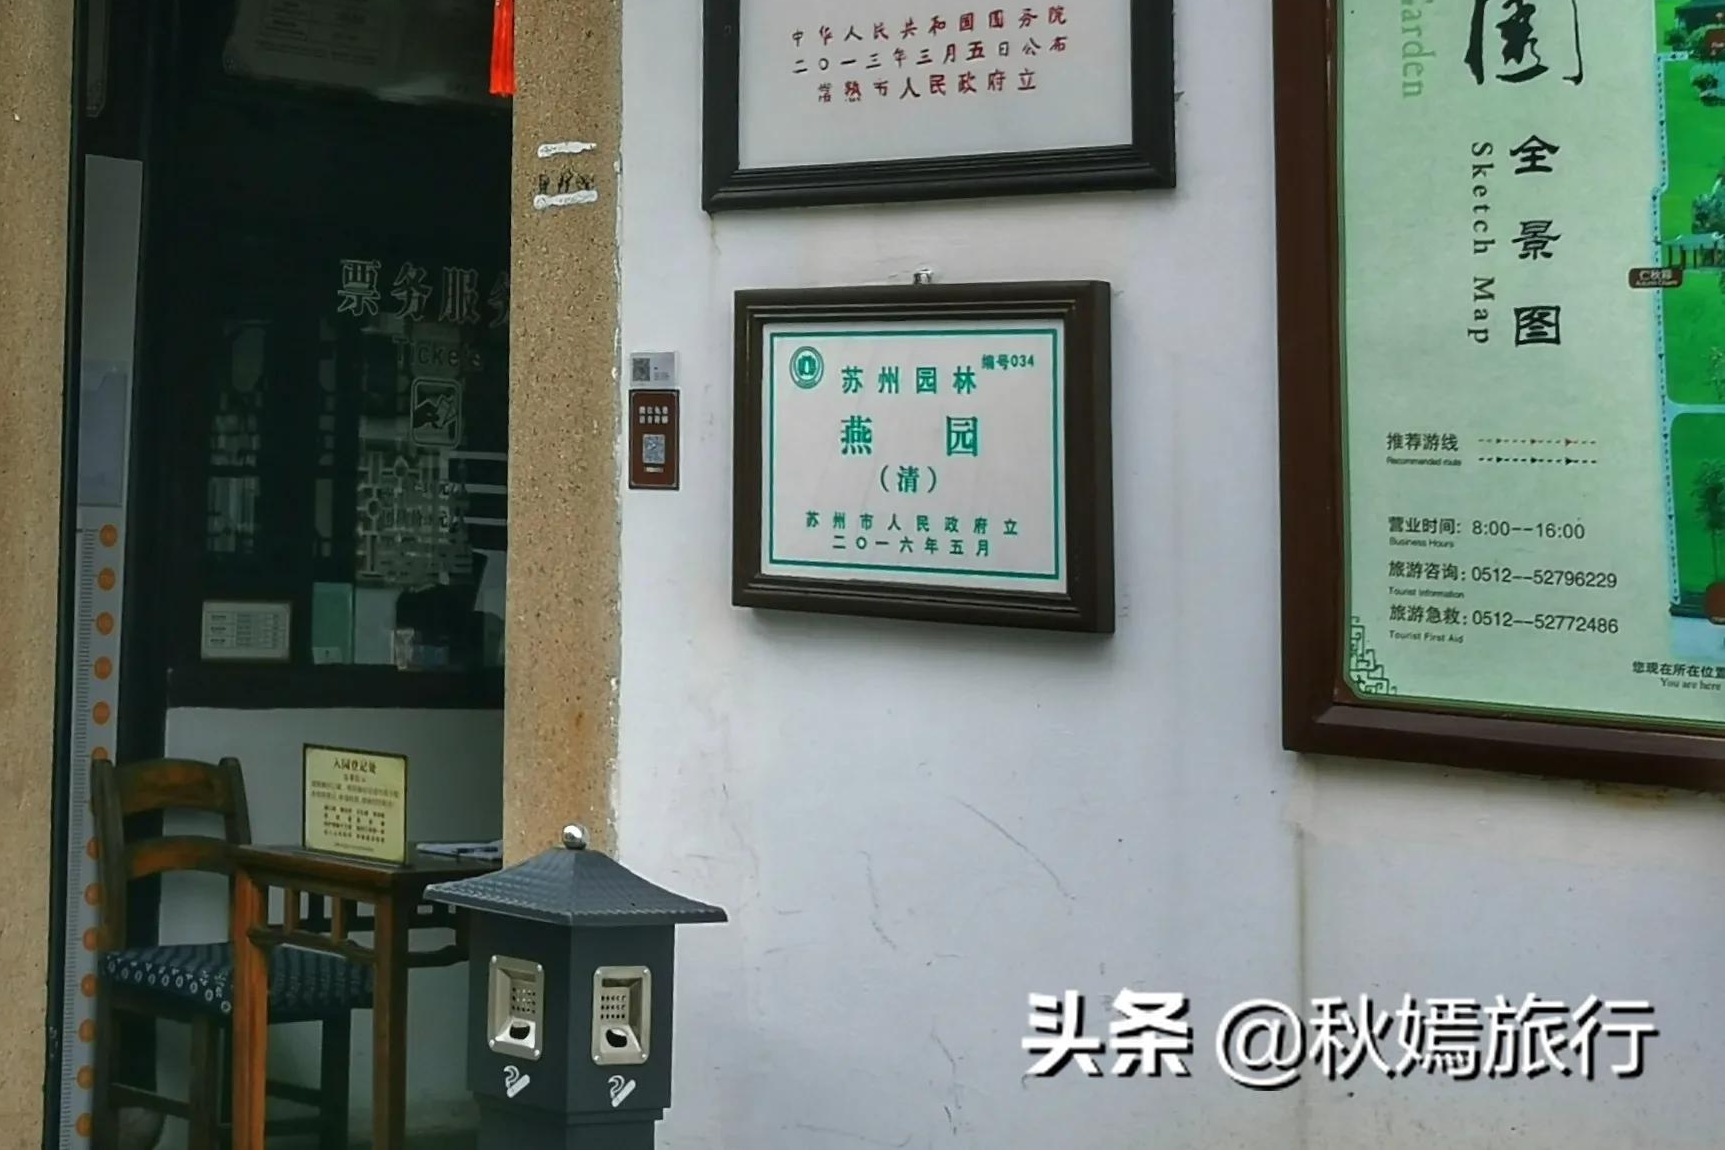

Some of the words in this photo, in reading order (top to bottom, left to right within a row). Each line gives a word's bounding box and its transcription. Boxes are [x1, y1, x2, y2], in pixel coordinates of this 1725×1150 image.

[791, 5, 1069, 47] 中华人民共和国国务院
[817, 67, 1037, 103] 常熟市人民政府立
[1470, 141, 1495, 254] Sketch
[1509, 134, 1562, 346] 全景图
[1466, 276, 1496, 344] Map
[981, 354, 1035, 371] 编号034
[840, 364, 977, 395] 苏州园林
[840, 414, 979, 458] 燕园
[1385, 431, 1459, 452] 推荐游线
[879, 465, 939, 494] （清）
[804, 510, 1019, 536] 苏州市人民政府立
[1388, 536, 1427, 547] Business
[1428, 538, 1455, 548] Hours
[1388, 630, 1422, 641] Tourist
[1660, 677, 1679, 688] You
